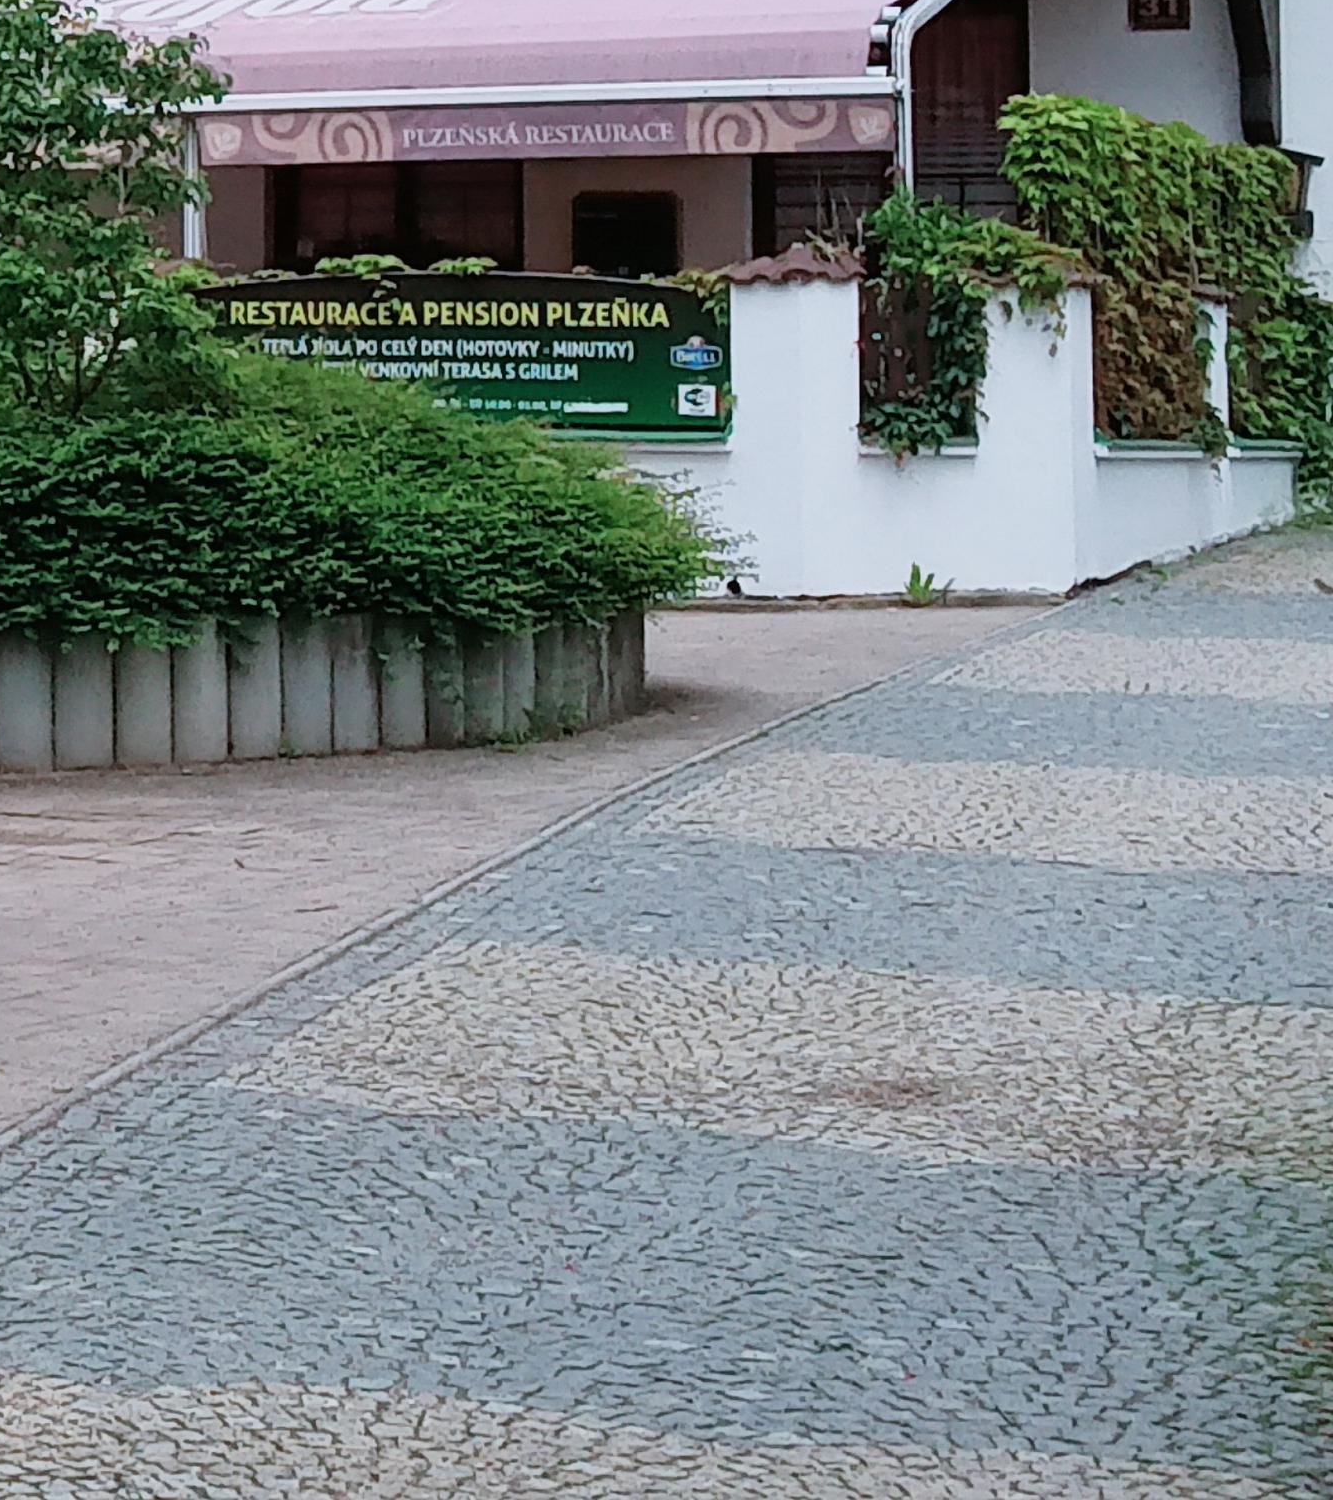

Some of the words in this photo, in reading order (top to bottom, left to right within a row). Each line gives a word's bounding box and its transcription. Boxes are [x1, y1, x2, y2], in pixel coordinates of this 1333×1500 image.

[402, 111, 519, 148] PLZEŇSKÁ
[525, 111, 676, 145] RESTAURACE
[230, 300, 393, 326] RESTAURACE
[398, 300, 418, 326] A
[423, 300, 539, 327] PENSION
[546, 297, 670, 328] PLZEŇKA
[356, 339, 378, 357] PO
[381, 336, 418, 357] CELÝ
[421, 338, 454, 357] DEN
[456, 338, 540, 359] (HOTOVKY
[552, 340, 634, 362] MINUTKY)
[441, 361, 502, 380] TERASA
[504, 362, 516, 380] S
[518, 362, 579, 381] GRILEM
